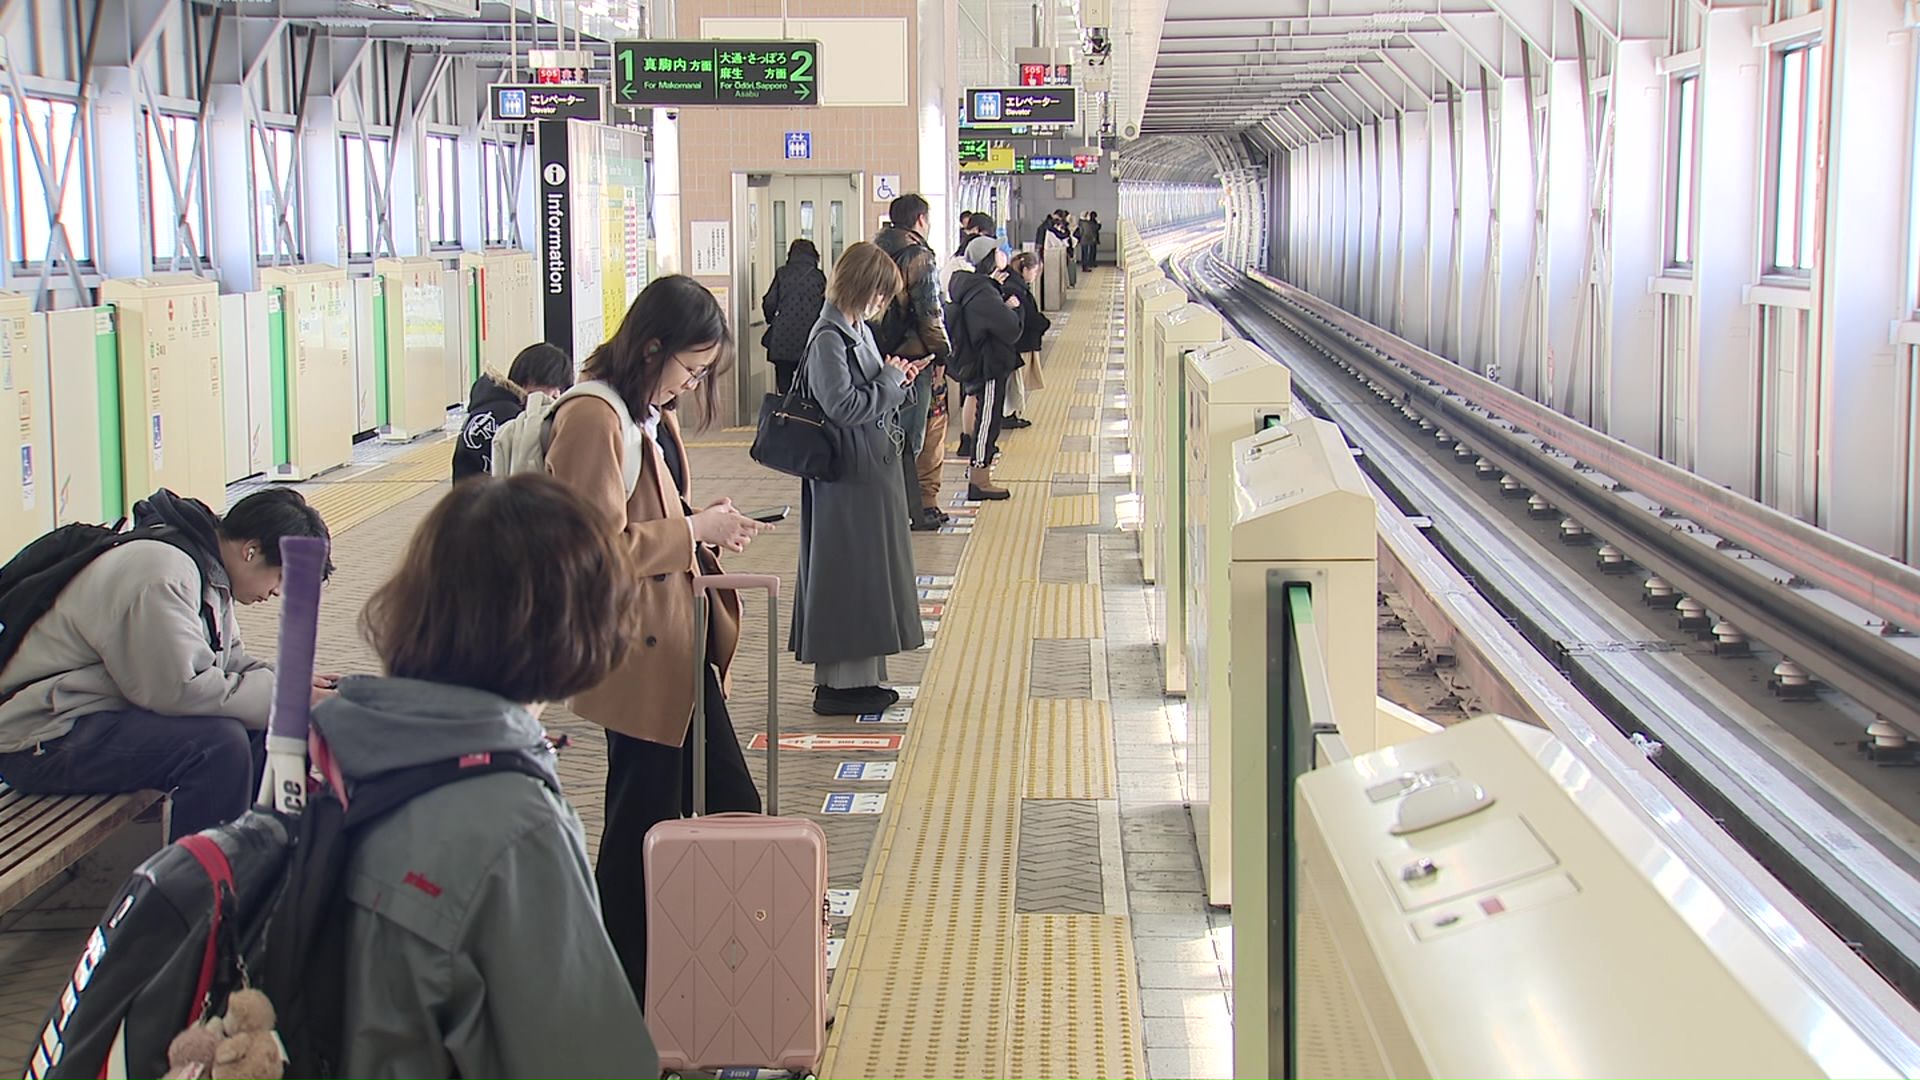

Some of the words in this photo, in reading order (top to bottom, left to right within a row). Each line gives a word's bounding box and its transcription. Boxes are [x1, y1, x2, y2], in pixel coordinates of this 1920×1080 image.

[618, 50, 633, 81] 1
[643, 57, 687, 72] 真駒内
[689, 60, 713, 72] 方面
[790, 50, 814, 82] 2
[1024, 66, 1041, 74] SOS
[540, 69, 557, 77] SOS
[719, 67, 744, 80] 麻生
[764, 67, 787, 80] 方面
[643, 81, 656, 89] For
[658, 81, 702, 89] Makomanai
[530, 94, 585, 106] エレベーター
[1005, 96, 1060, 107] エレベーター
[547, 194, 565, 294] Information
